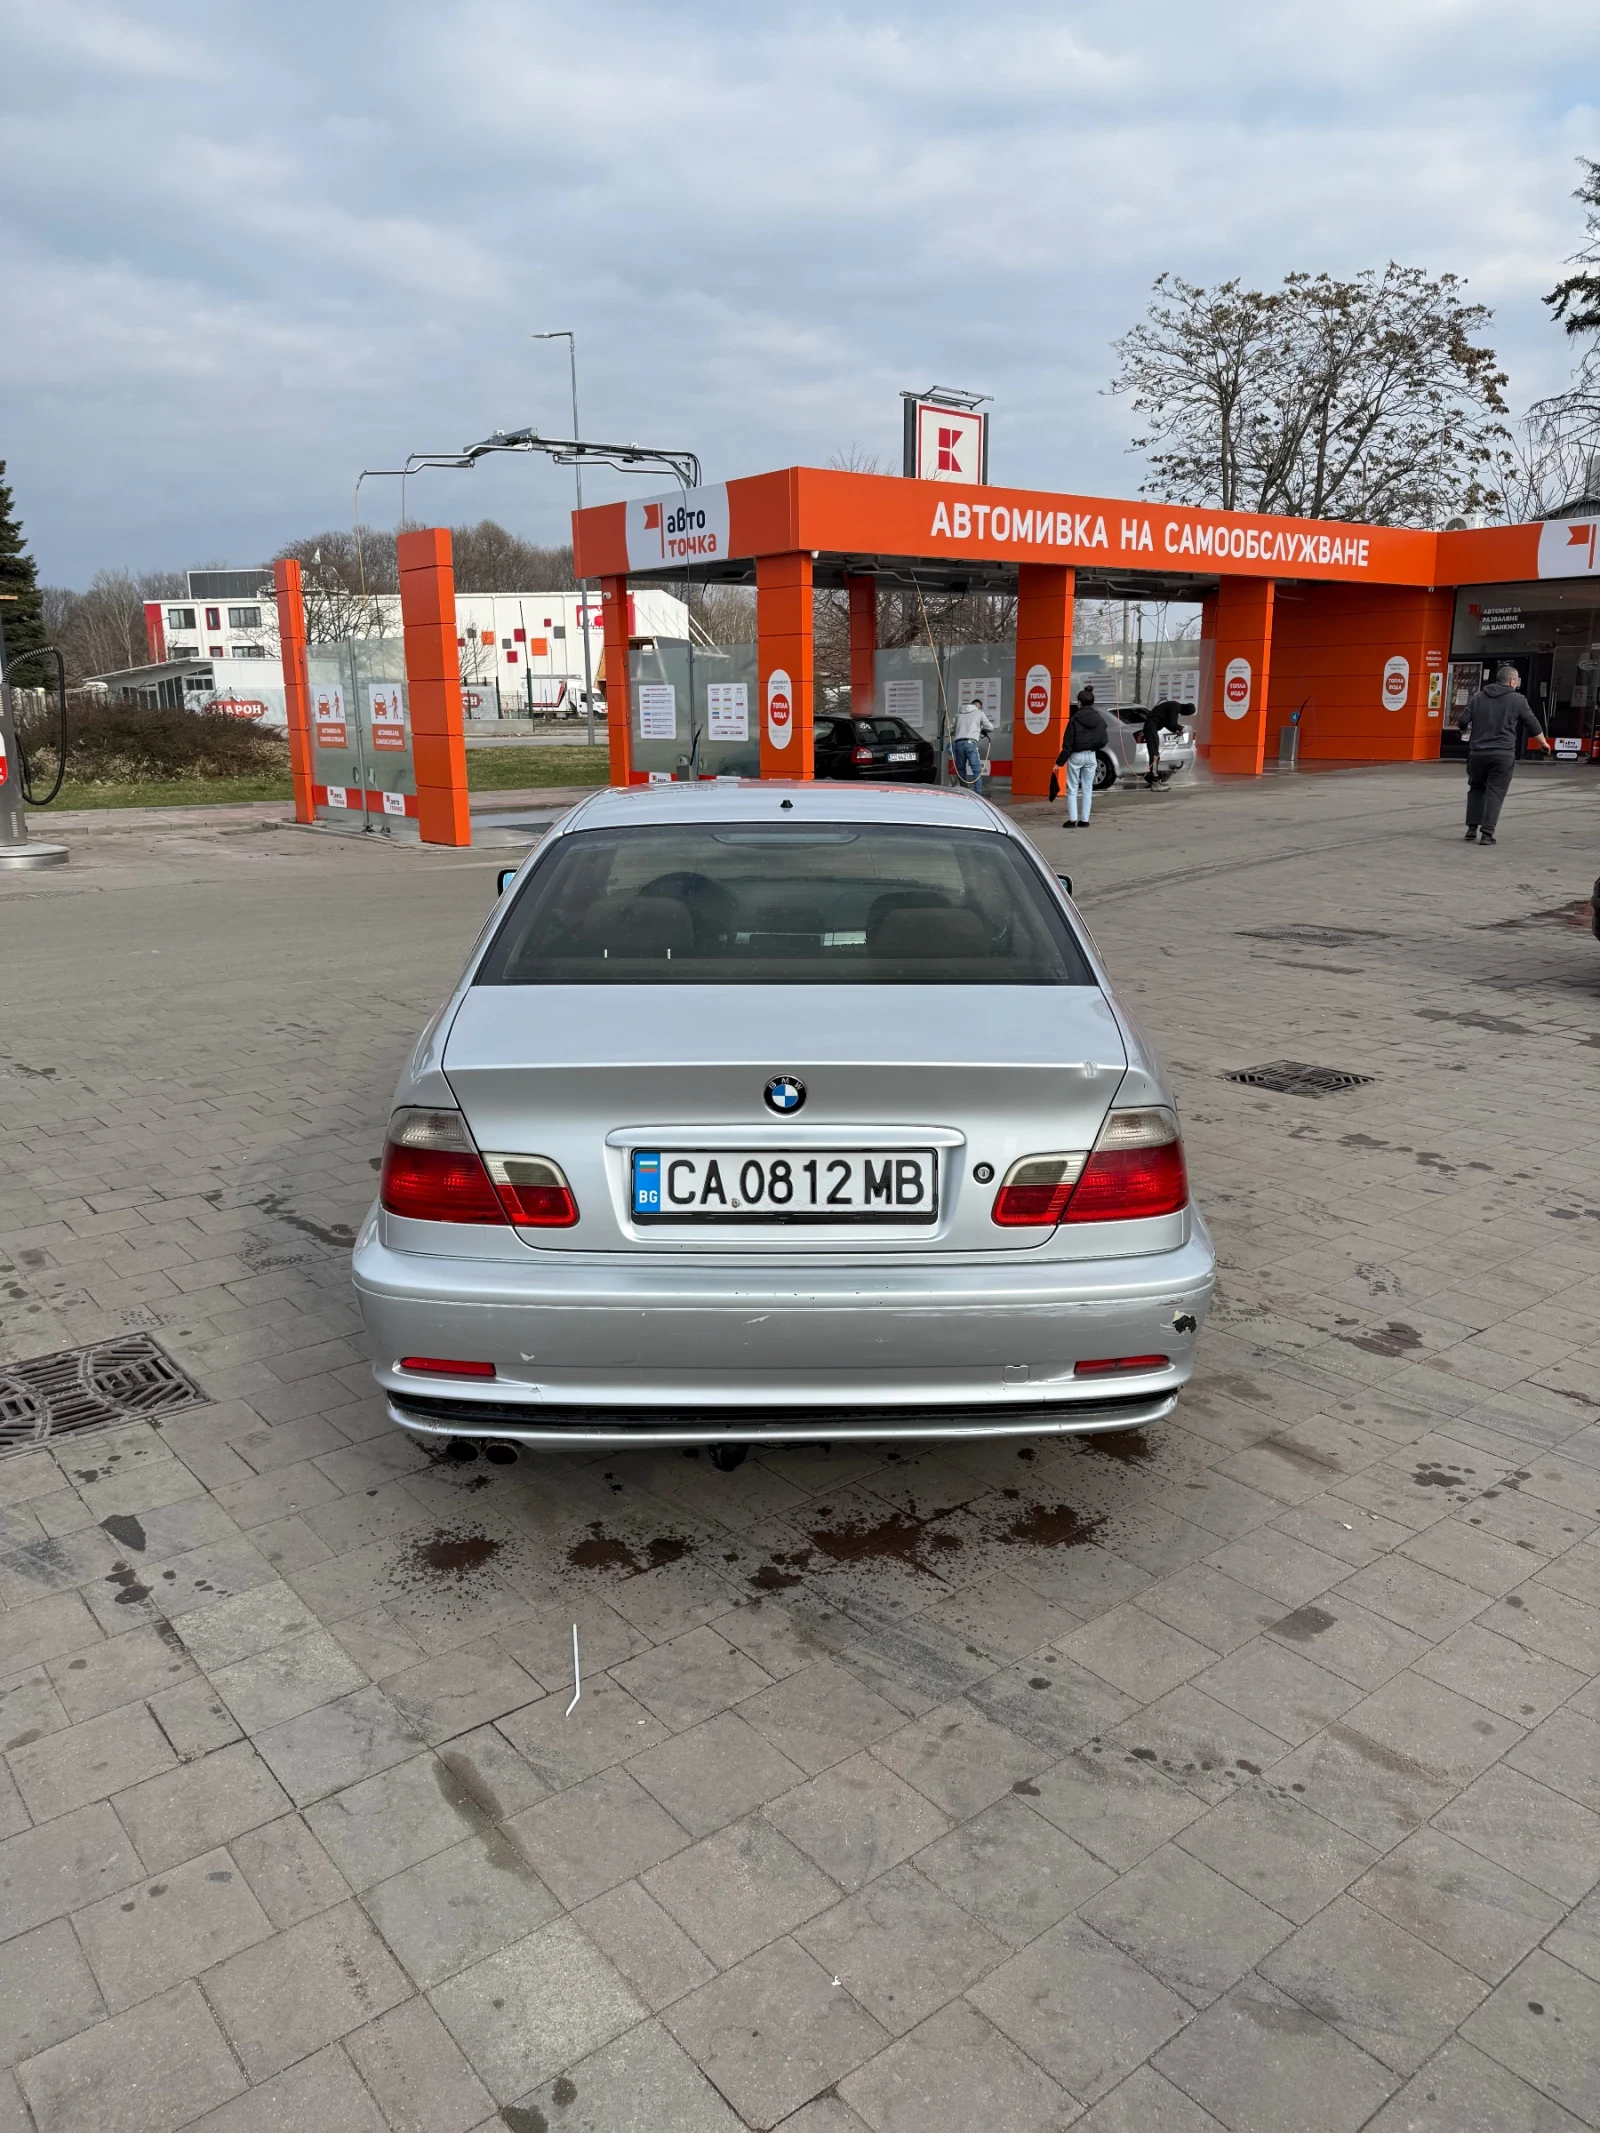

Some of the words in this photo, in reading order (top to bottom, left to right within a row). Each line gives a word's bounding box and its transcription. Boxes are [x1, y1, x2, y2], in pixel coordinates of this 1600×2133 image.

[930, 501, 1109, 549] АВТОМИВКА
[1121, 518, 1154, 551] НА
[1165, 522, 1370, 567] САМООБСЛУЖВАНЕ
[769, 1077, 803, 1090] BMW
[639, 1189, 658, 1204] BG
